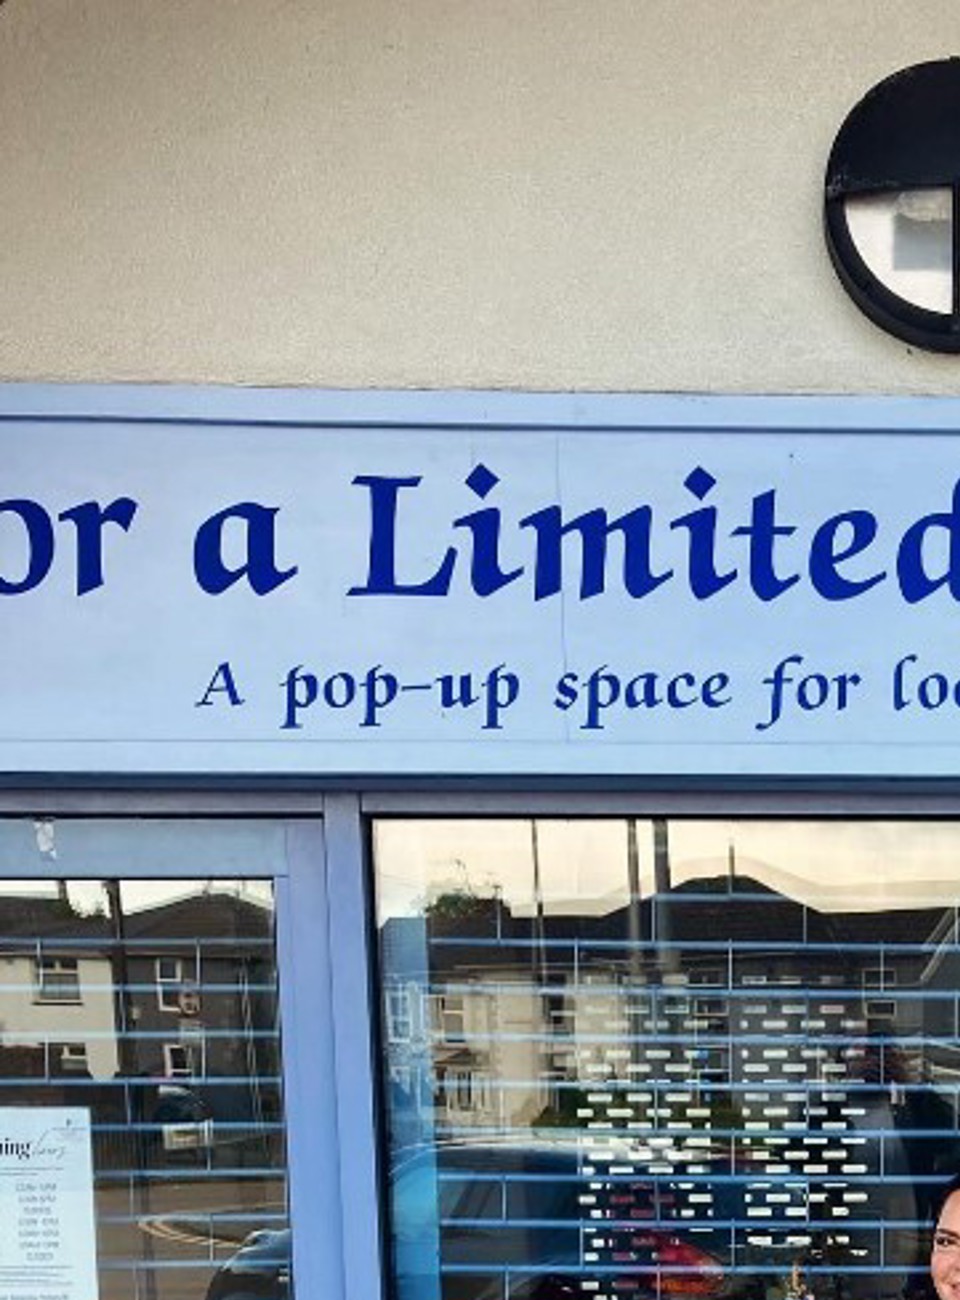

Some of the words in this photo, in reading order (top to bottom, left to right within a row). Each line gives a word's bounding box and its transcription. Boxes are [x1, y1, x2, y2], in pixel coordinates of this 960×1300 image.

[193, 501, 298, 597] a
[196, 661, 244, 707] A
[279, 663, 520, 730] pop-up
[553, 664, 732, 730] space
[755, 654, 862, 731] for
